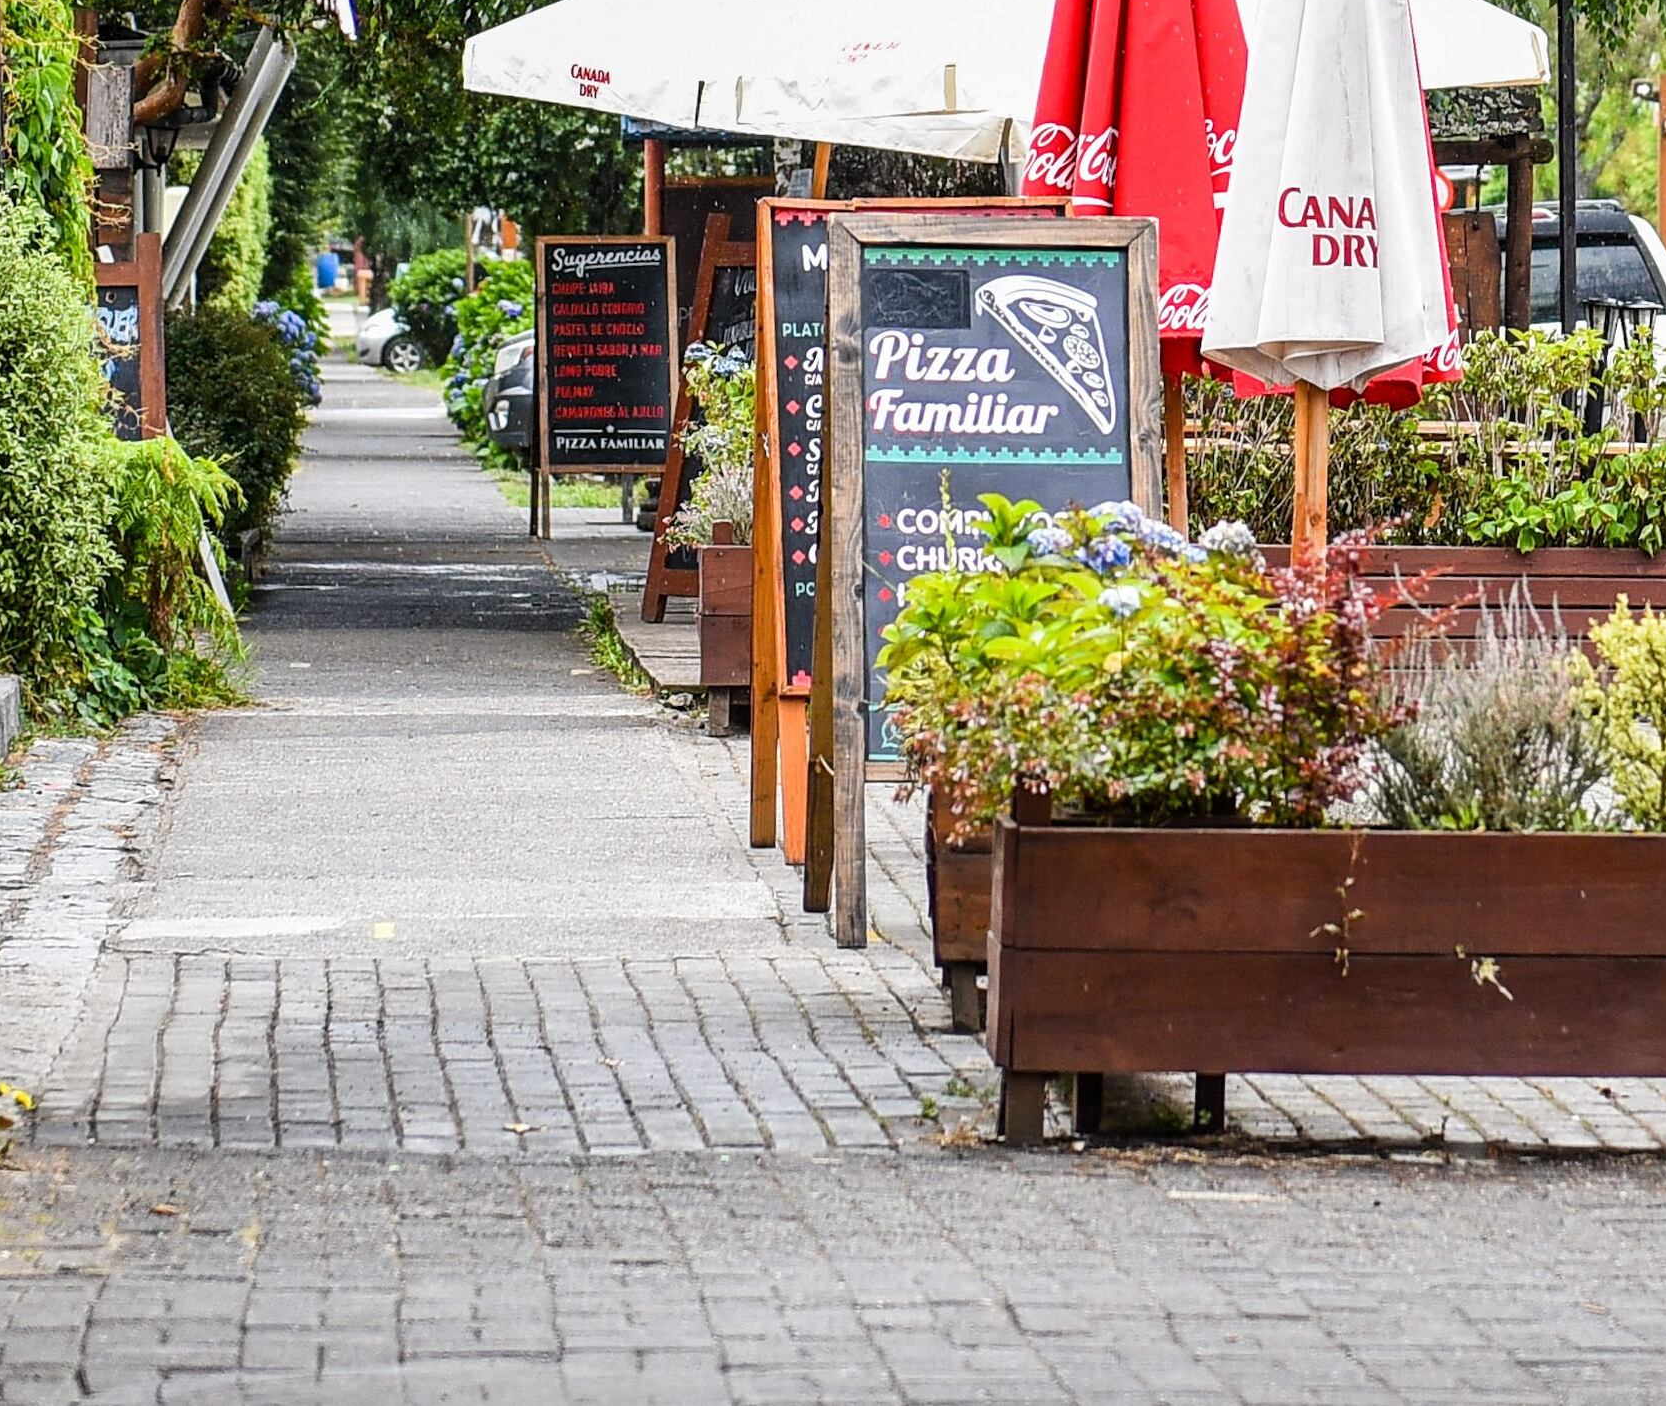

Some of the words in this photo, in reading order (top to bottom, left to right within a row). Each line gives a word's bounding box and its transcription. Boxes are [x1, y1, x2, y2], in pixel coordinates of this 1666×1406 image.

[570, 64, 611, 85] CANADA
[579, 83, 599, 99] DRY
[1312, 234, 1379, 269] DRY
[551, 248, 661, 278] Sugerencias
[553, 323, 587, 336] PASTEL
[590, 323, 604, 336] DE
[596, 344, 630, 357] SABOR
[868, 330, 1017, 383] Pizza
[585, 364, 618, 378] POBRE
[868, 389, 1061, 434] Familiar
[555, 437, 598, 454] PIZZA
[599, 438, 666, 451] FAMILIAR
